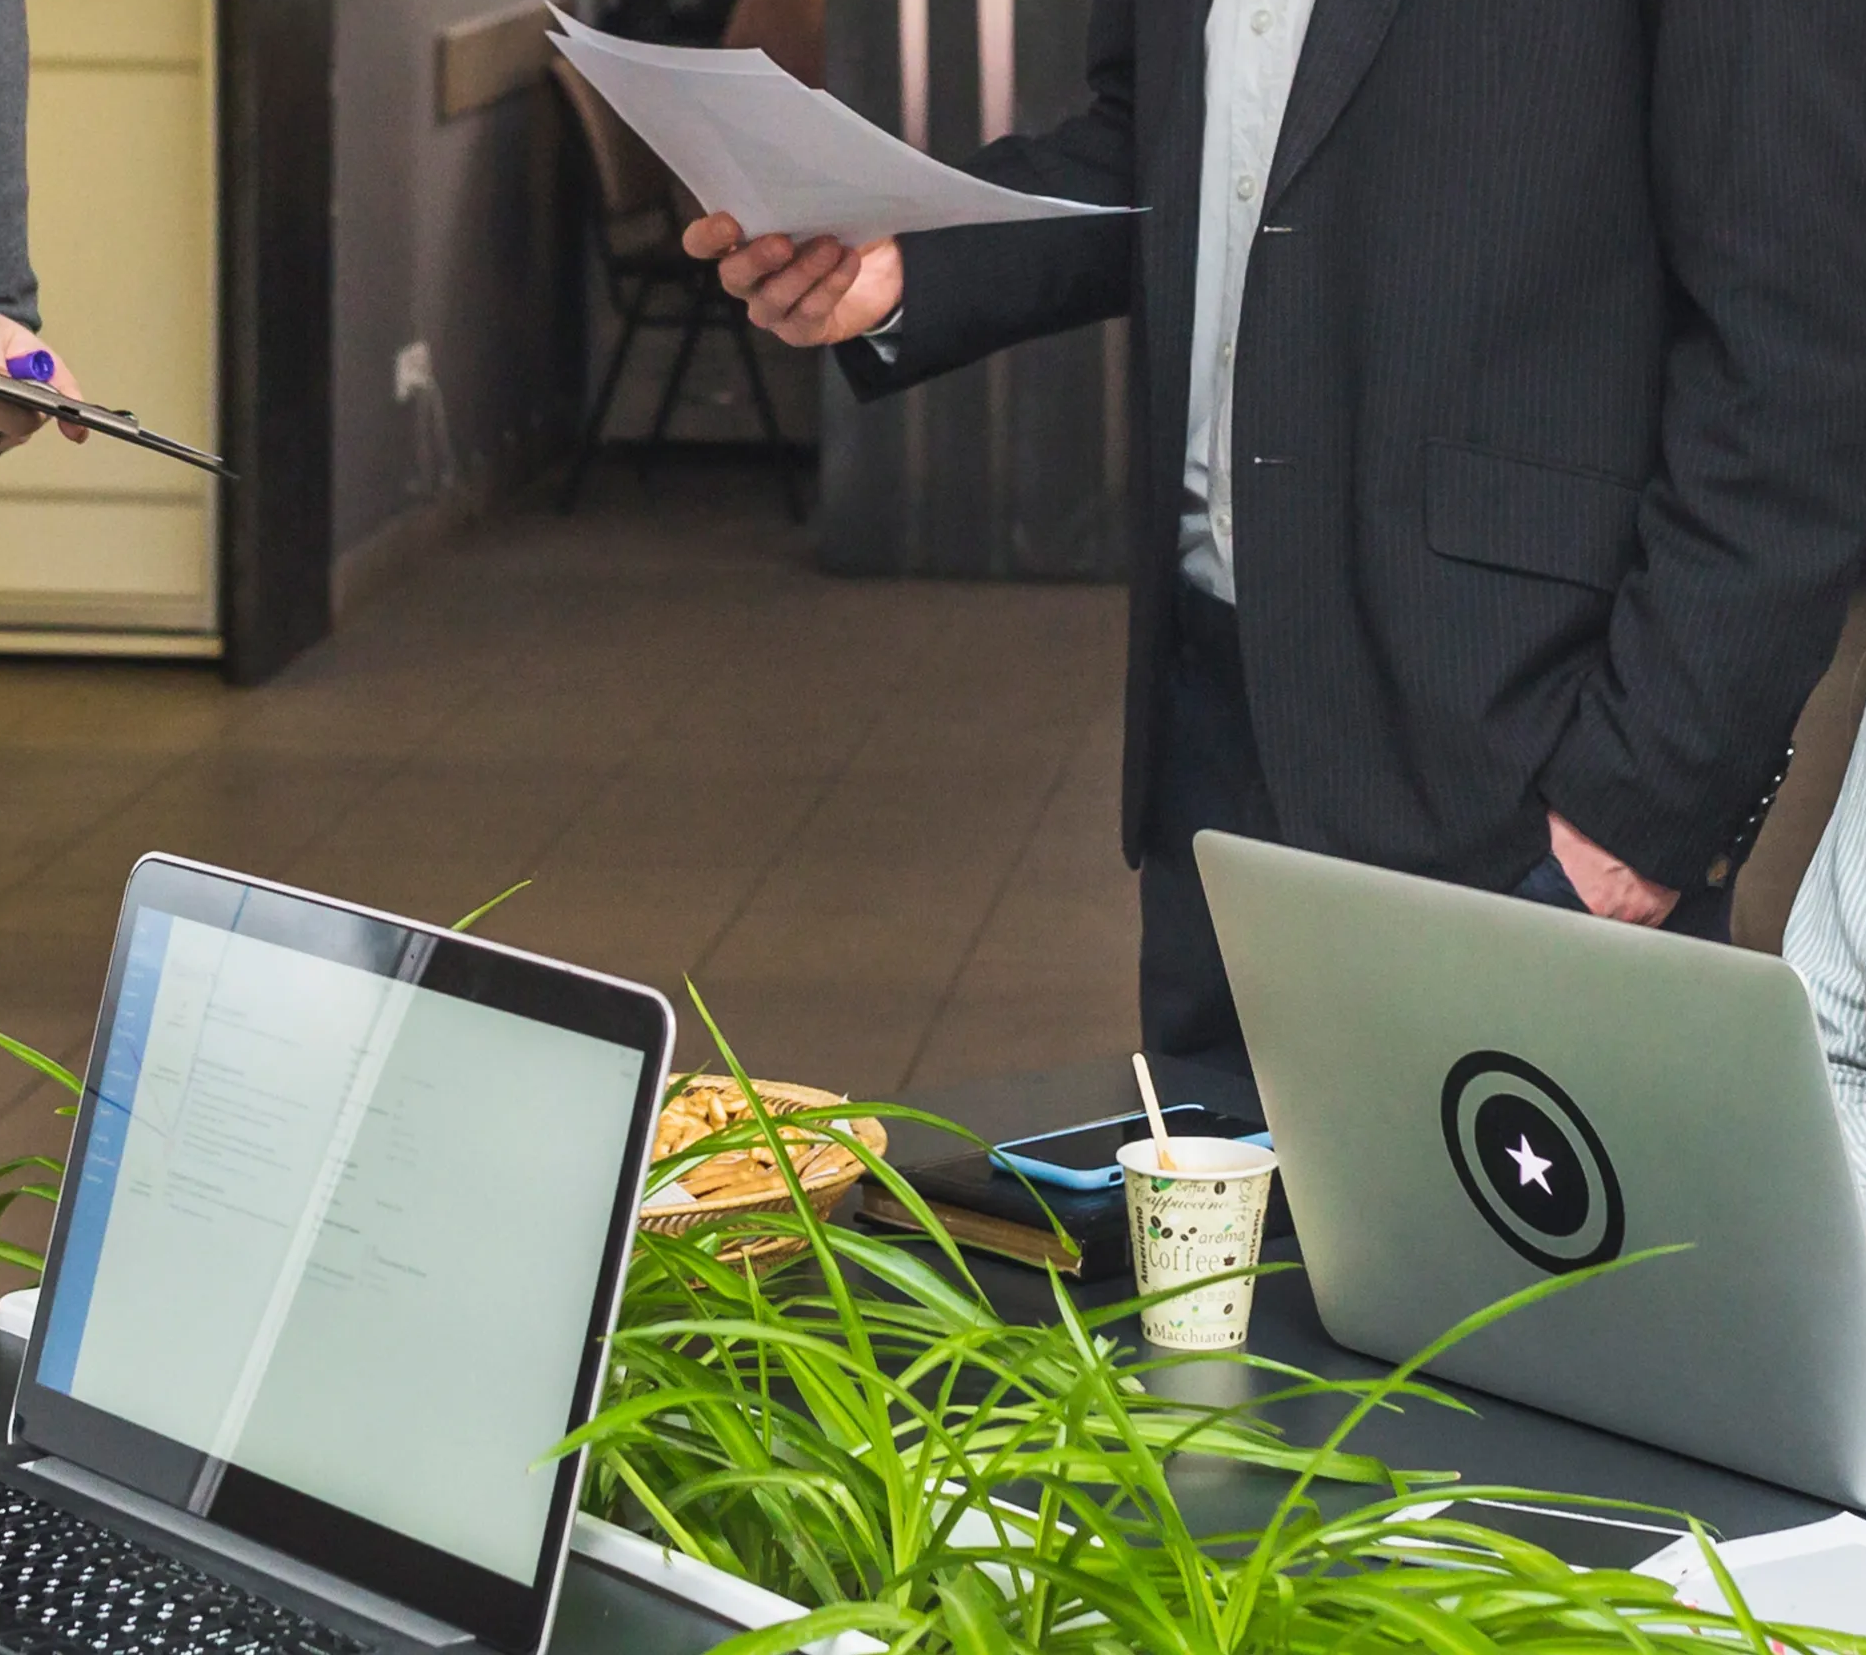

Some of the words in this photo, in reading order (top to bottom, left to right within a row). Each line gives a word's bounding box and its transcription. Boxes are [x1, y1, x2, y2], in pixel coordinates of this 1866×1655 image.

[1135, 1205, 1149, 1285] Americano
[1198, 1231, 1246, 1245] aroma
[1148, 1241, 1221, 1273] Coffee
[1153, 1322, 1226, 1344] Macchiato
